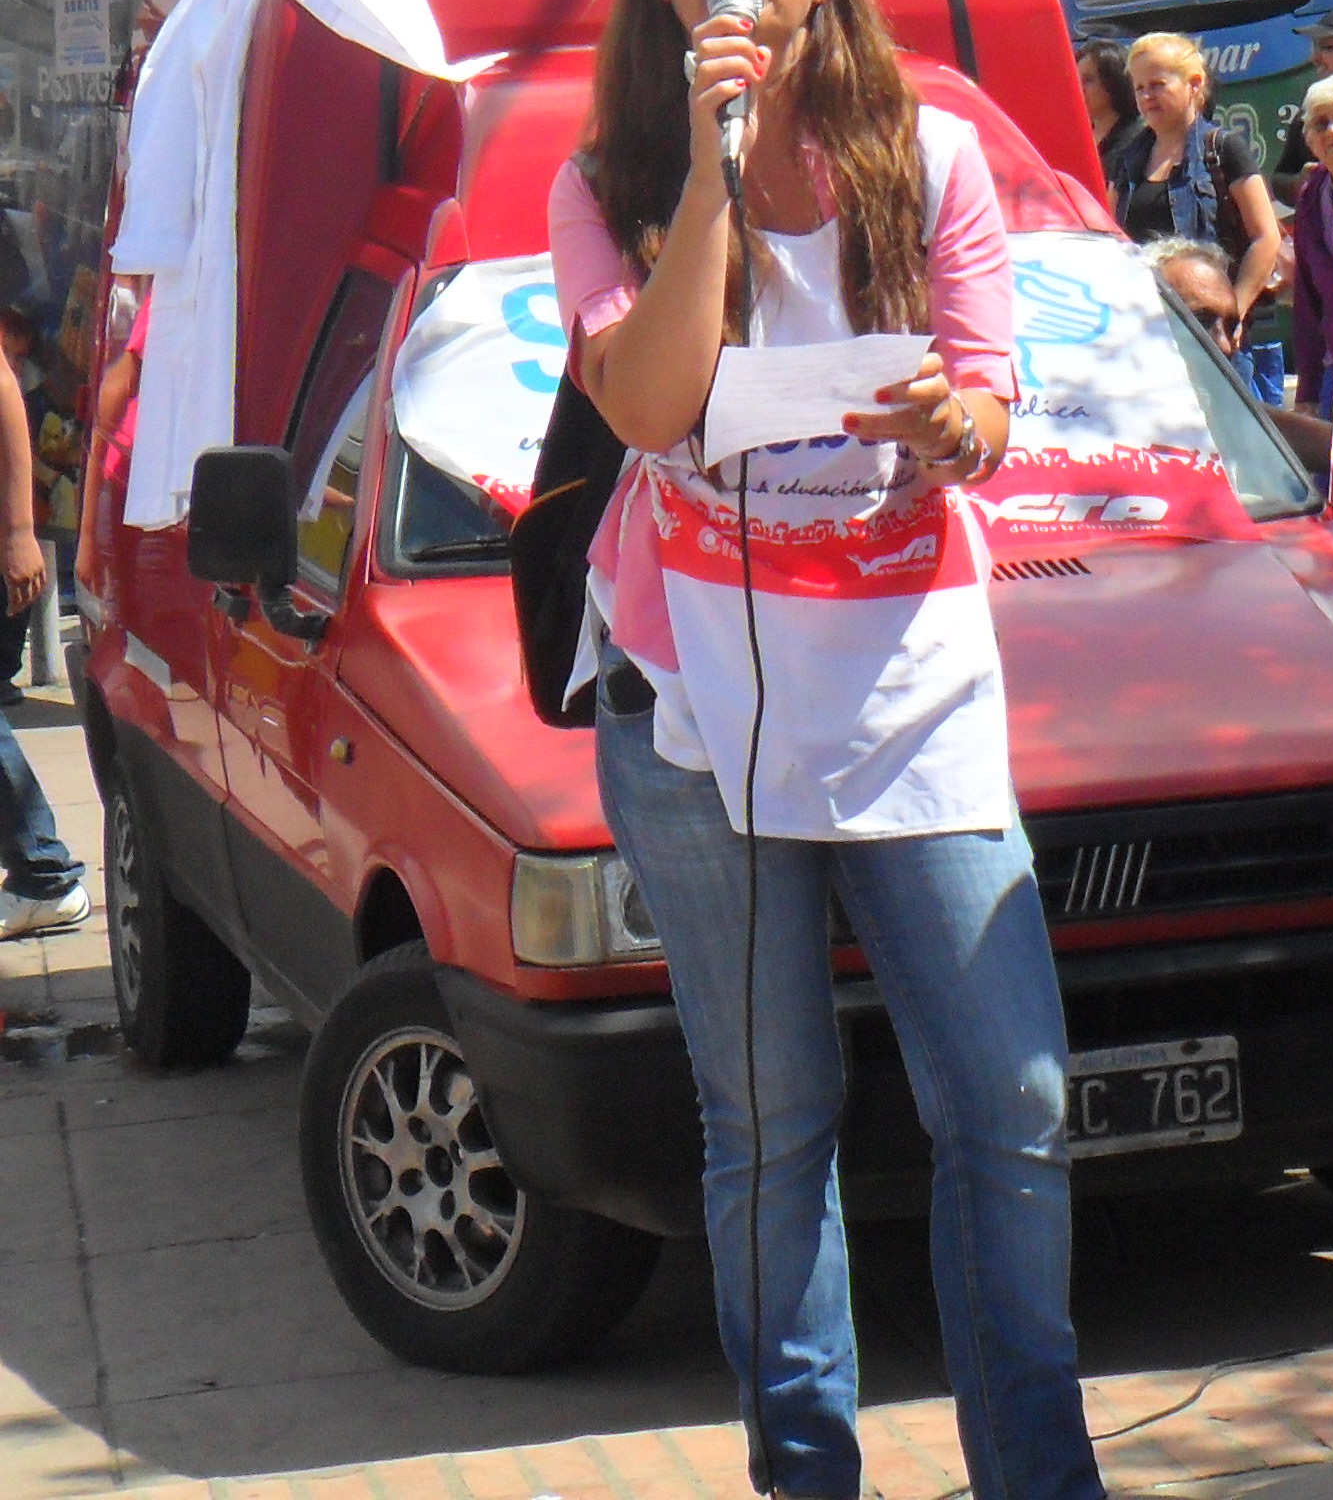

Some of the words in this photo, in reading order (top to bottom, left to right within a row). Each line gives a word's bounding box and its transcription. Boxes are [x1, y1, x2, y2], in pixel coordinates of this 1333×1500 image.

[777, 477, 870, 497] educación
[1010, 522, 1030, 533] de
[1034, 521, 1057, 533] los
[1141, 1063, 1232, 1126] 762
